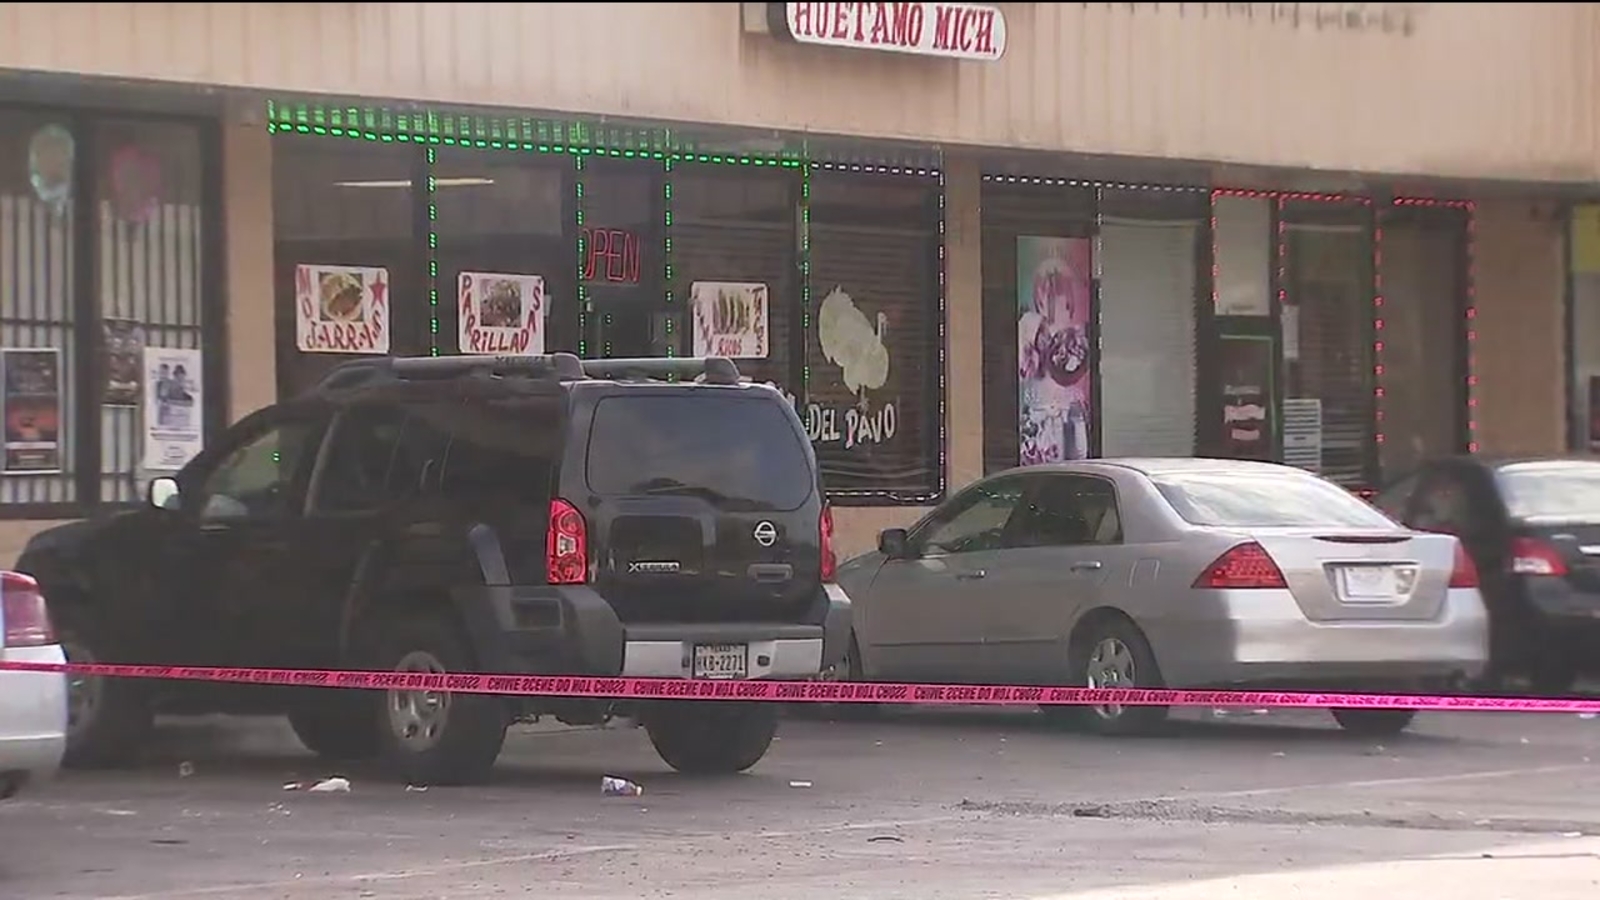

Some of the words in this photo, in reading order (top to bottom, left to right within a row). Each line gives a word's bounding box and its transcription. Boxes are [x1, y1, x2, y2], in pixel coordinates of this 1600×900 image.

[795, 2, 923, 46] HUETAMO
[932, 5, 997, 55] MICH.
[579, 228, 641, 282] OPEN
[808, 403, 841, 441] DEL
[845, 403, 895, 449] PAVO
